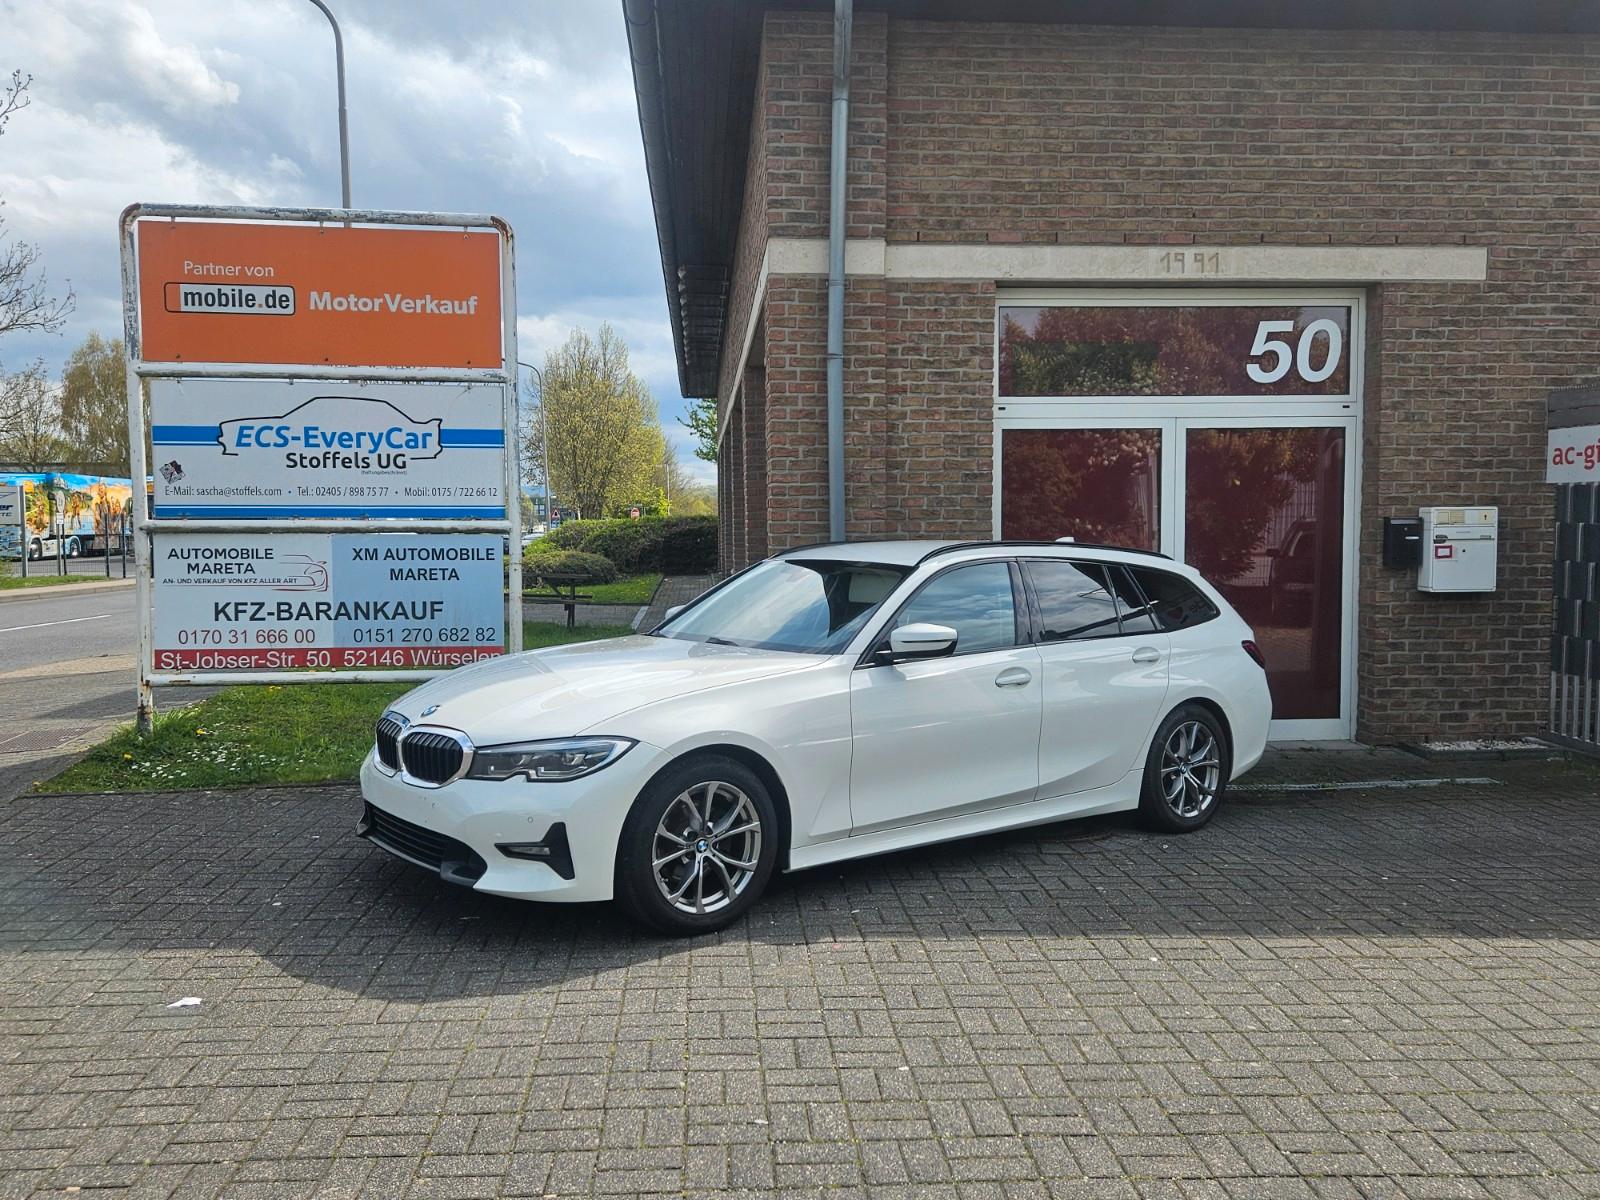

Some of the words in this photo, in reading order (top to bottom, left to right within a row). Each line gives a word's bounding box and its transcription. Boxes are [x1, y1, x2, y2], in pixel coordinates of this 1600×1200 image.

[184, 261, 241, 277] Partner
[245, 265, 274, 277] von
[1160, 252, 1219, 273] 1991
[183, 287, 290, 310] mobile.de
[1246, 318, 1343, 384] 50
[235, 425, 433, 454] ECS-EveryCar
[286, 452, 371, 469] Stoffels
[378, 454, 407, 469] UG
[165, 486, 194, 496] E-Mail:
[196, 486, 282, 497] sascha@stoffels.com
[297, 486, 314, 496] Tel.:
[316, 487, 341, 496] 02405
[350, 487, 365, 497] 898
[367, 487, 377, 497] 75
[379, 487, 389, 497] 77
[404, 487, 430, 497] Mobil:
[431, 487, 451, 497] 0175
[459, 487, 474, 497] 722
[476, 487, 486, 497] 66
[488, 487, 498, 497] 12
[167, 548, 274, 560] AUTOMOBILE
[352, 548, 379, 561] XM
[384, 548, 496, 561] AUTOMOBILE
[187, 563, 255, 575] MARETA
[390, 568, 460, 581] MARETA
[214, 601, 444, 622] KFZ-BARANKAUF
[178, 629, 222, 645] 0170
[228, 629, 248, 645] 31
[255, 629, 288, 644] 666
[294, 629, 316, 644] 00
[353, 628, 395, 644] 0151
[401, 628, 433, 643] 270
[438, 628, 471, 643] 682
[475, 627, 496, 642] 82
[160, 651, 299, 670] St-Jobser-Str.
[306, 651, 331, 668] 50
[344, 650, 404, 667] 52146
